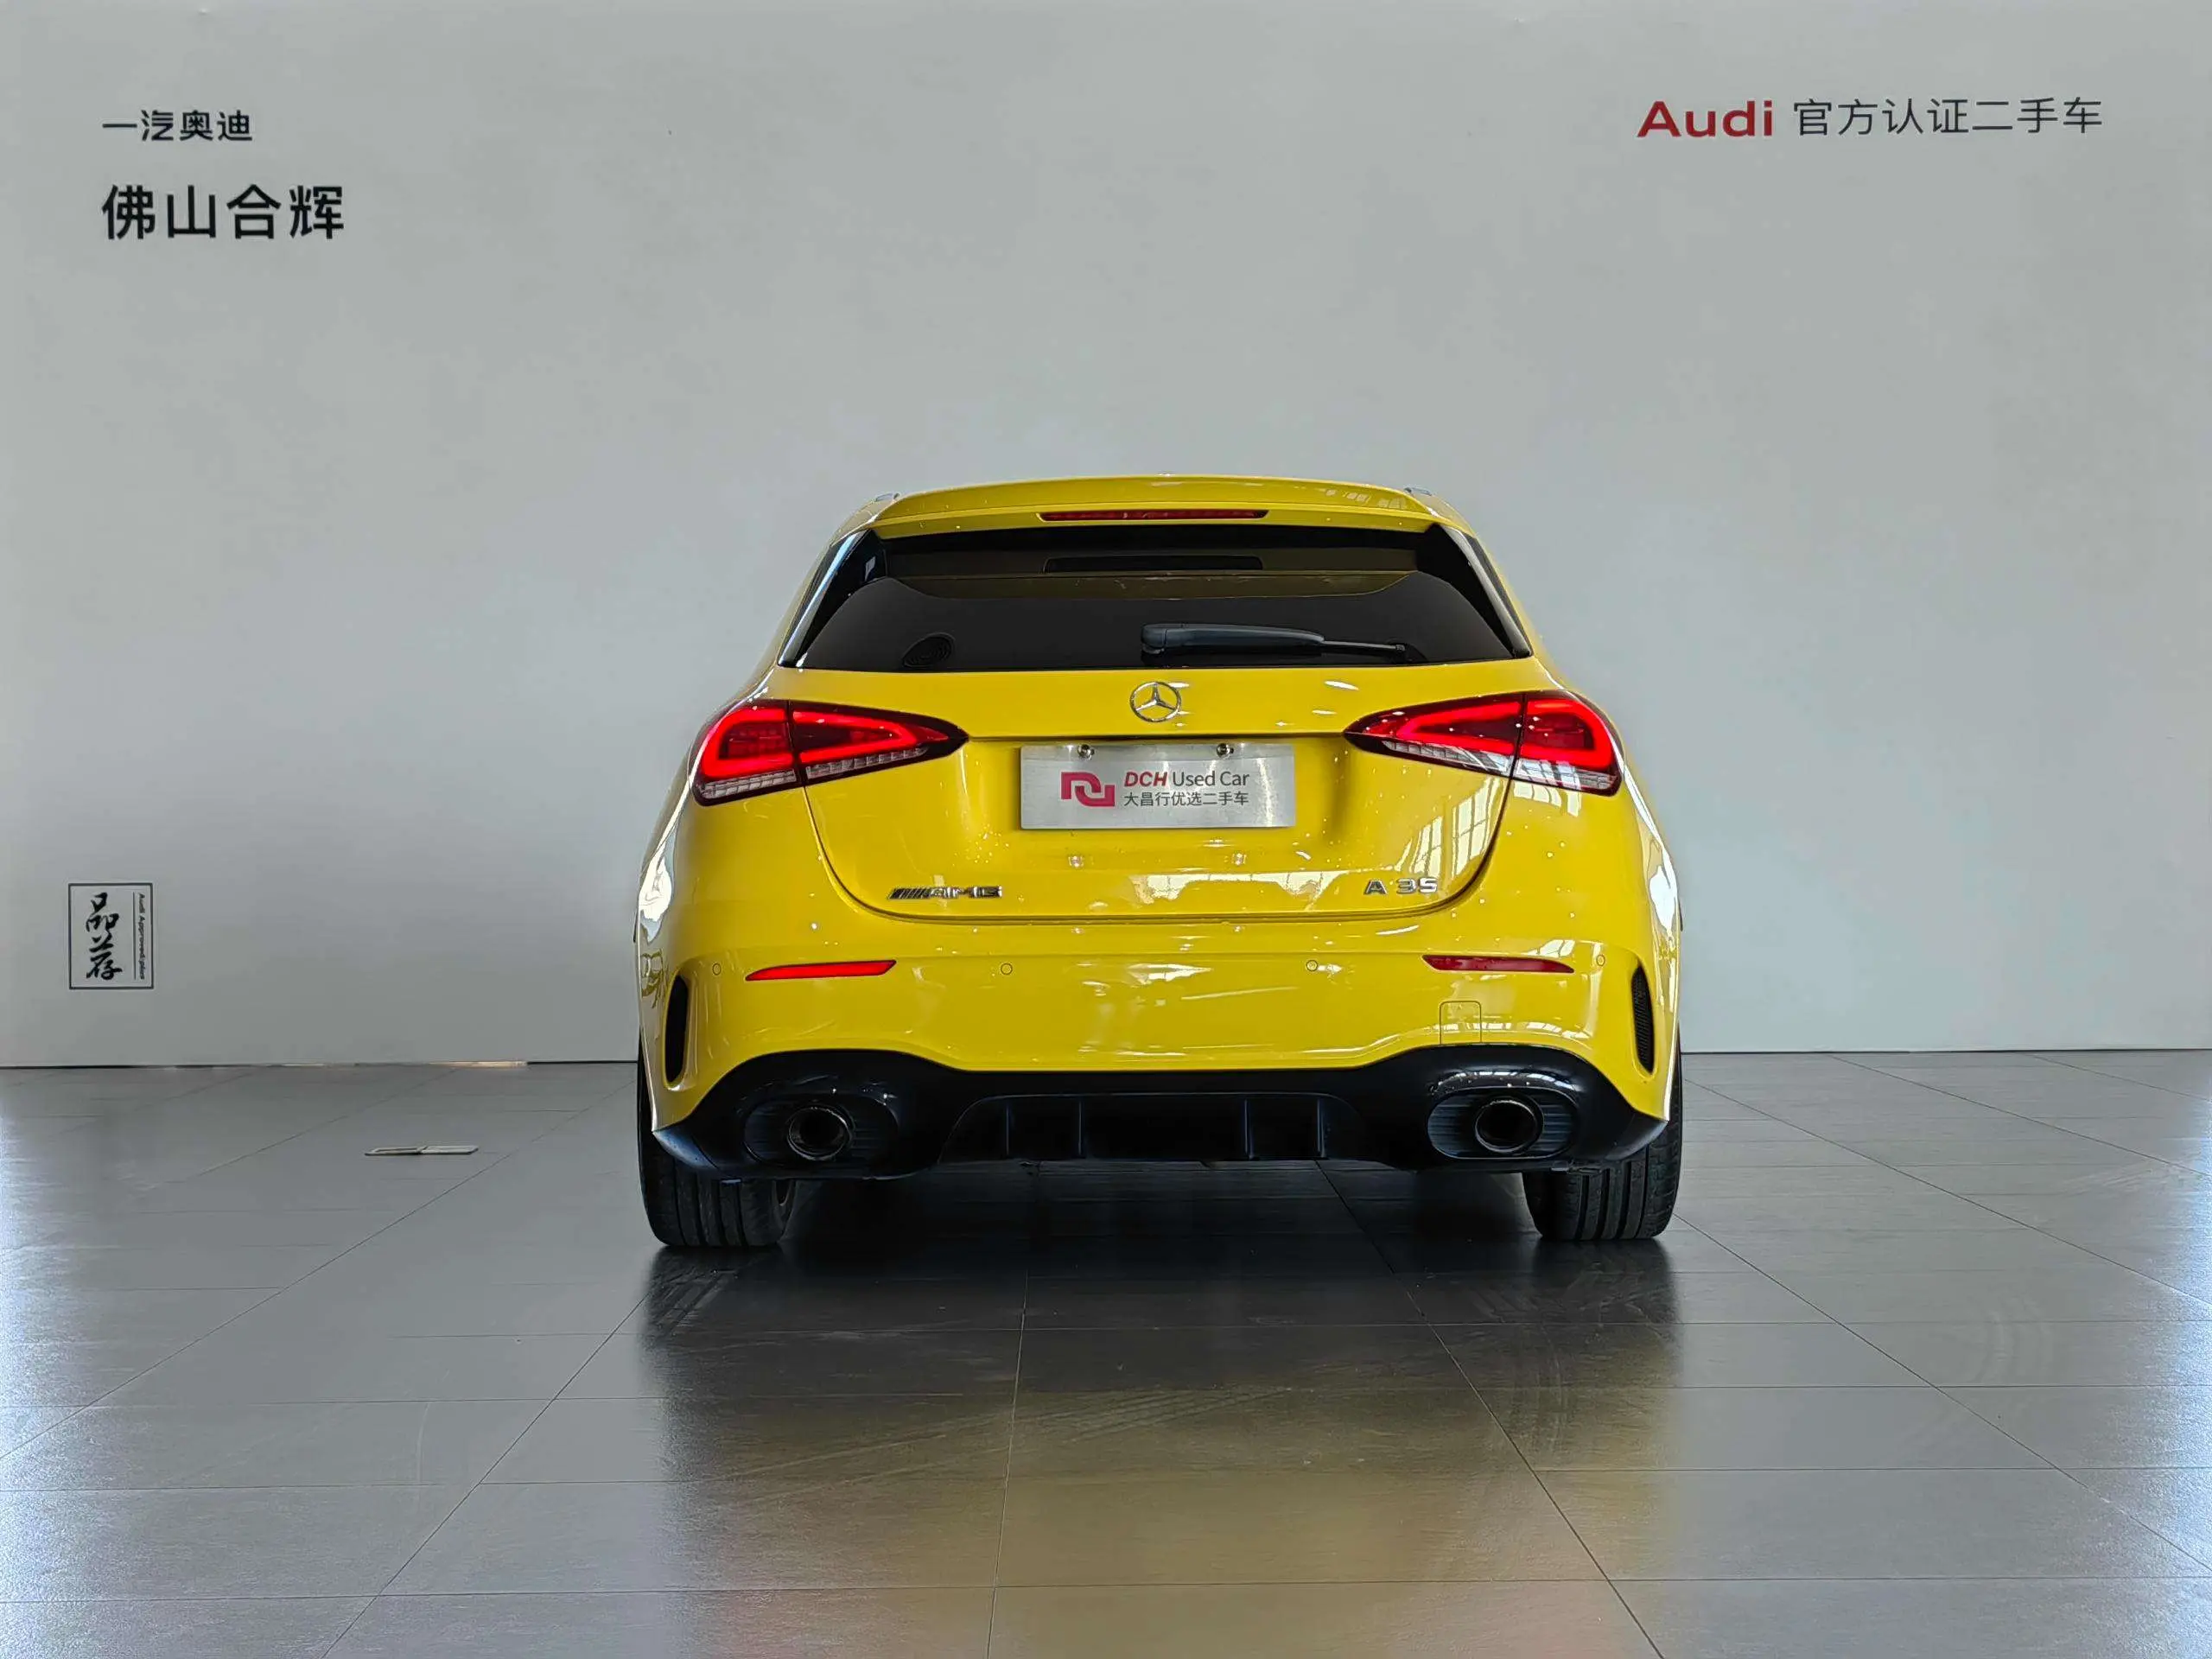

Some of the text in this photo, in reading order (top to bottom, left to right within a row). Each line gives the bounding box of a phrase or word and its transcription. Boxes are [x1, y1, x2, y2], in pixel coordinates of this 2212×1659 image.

[102, 109, 253, 142] 一汽奥迪
[1637, 97, 2102, 138] Audi 官方认证二手车
[101, 184, 345, 240] 佛山合辉
[1124, 771, 1249, 787] DCH Used Car
[1124, 791, 1249, 807] 大昌行优选二手车
[927, 886, 1003, 899] AMG
[1363, 877, 1438, 894] A 35
